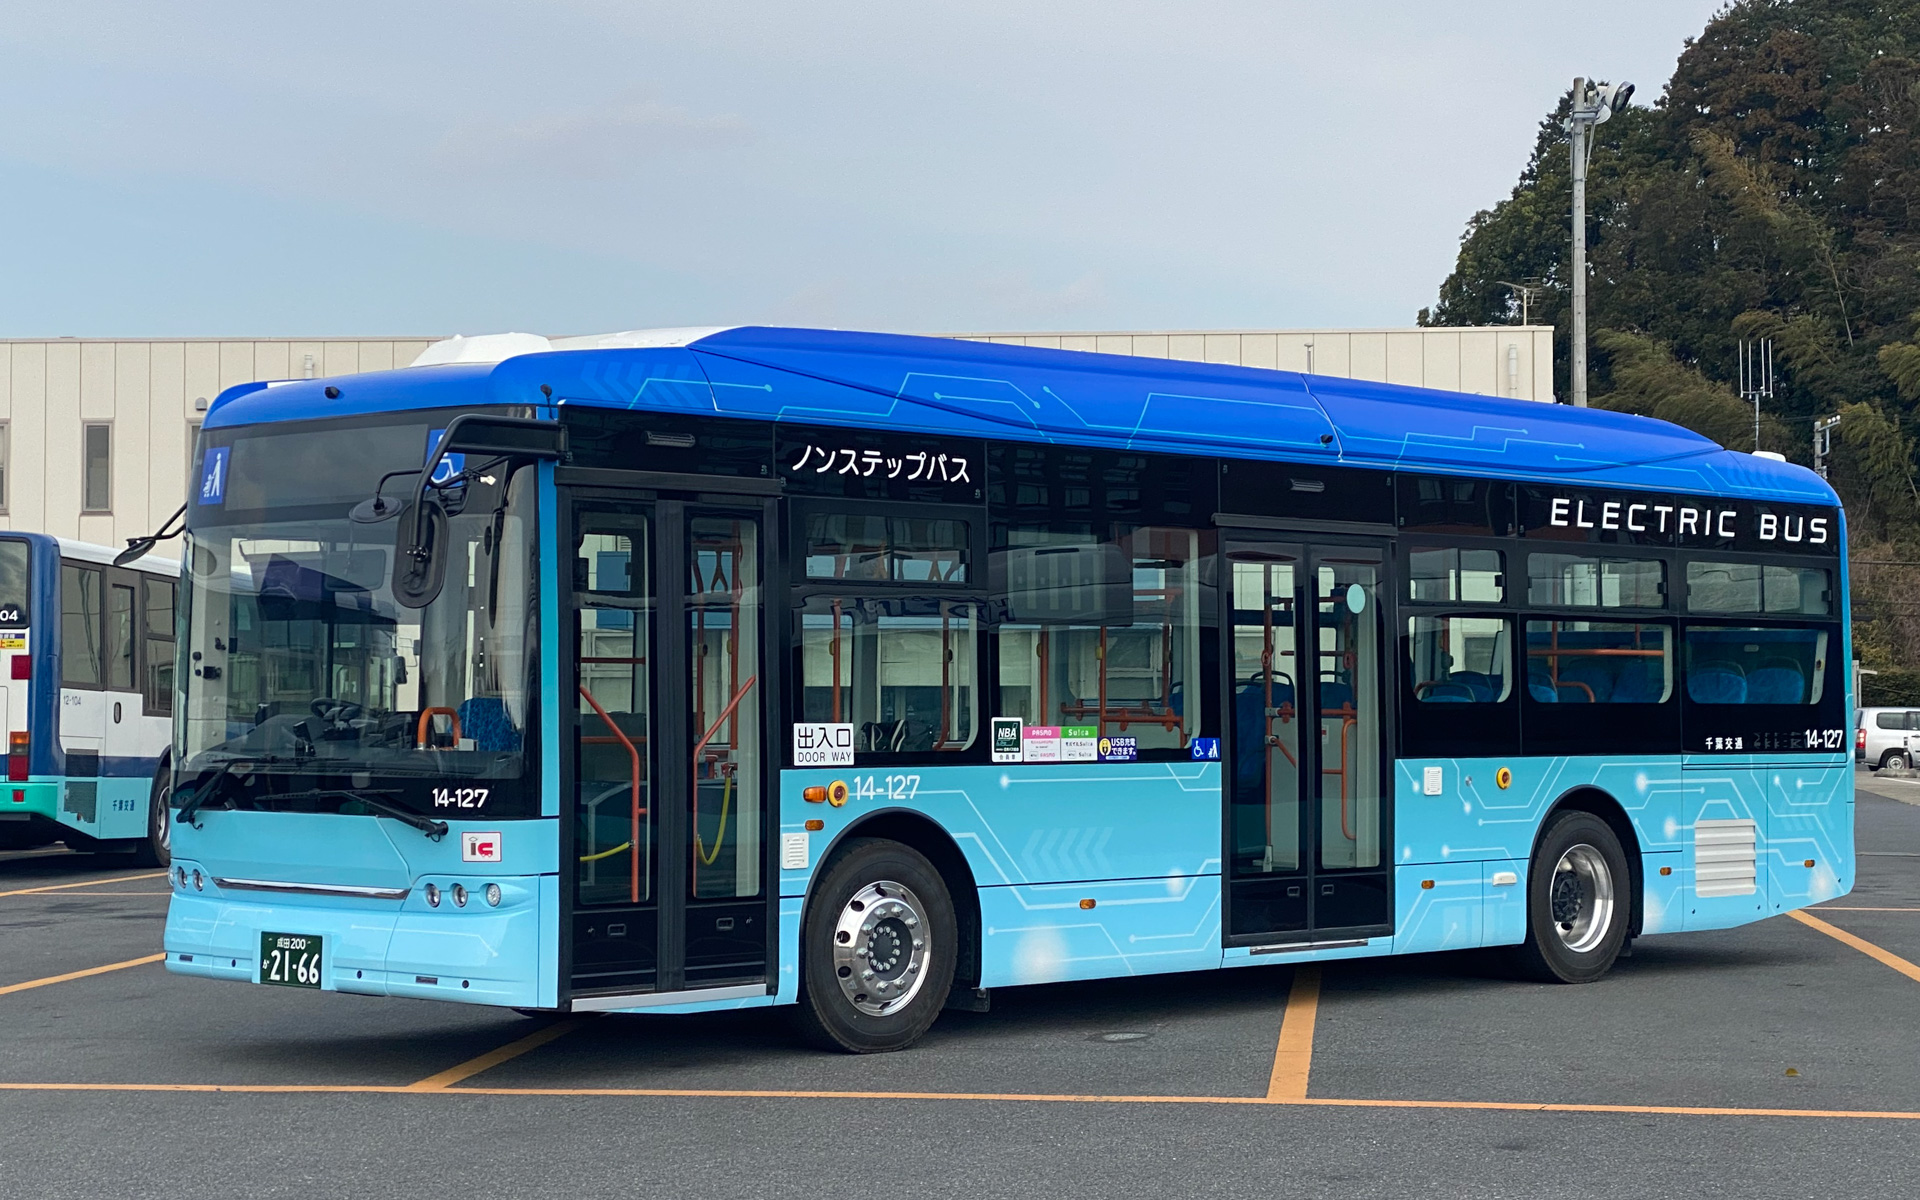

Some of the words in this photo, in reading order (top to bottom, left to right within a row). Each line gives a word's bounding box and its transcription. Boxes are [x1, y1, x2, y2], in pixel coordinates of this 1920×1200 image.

[792, 445, 970, 483] ノンステップバス
[1550, 498, 1737, 537] ELECTRIC
[1759, 513, 1828, 543] BUS
[798, 727, 851, 748] 出入口
[998, 727, 1017, 739] NBA
[1068, 728, 1090, 737] Suica
[1805, 729, 1843, 748] 14-127
[1705, 737, 1743, 750] 千葉交通
[798, 752, 826, 762] DOOR
[832, 751, 852, 762] WAY
[854, 775, 921, 801] 14-127
[432, 788, 489, 808] 14-127
[290, 938, 306, 950] 200
